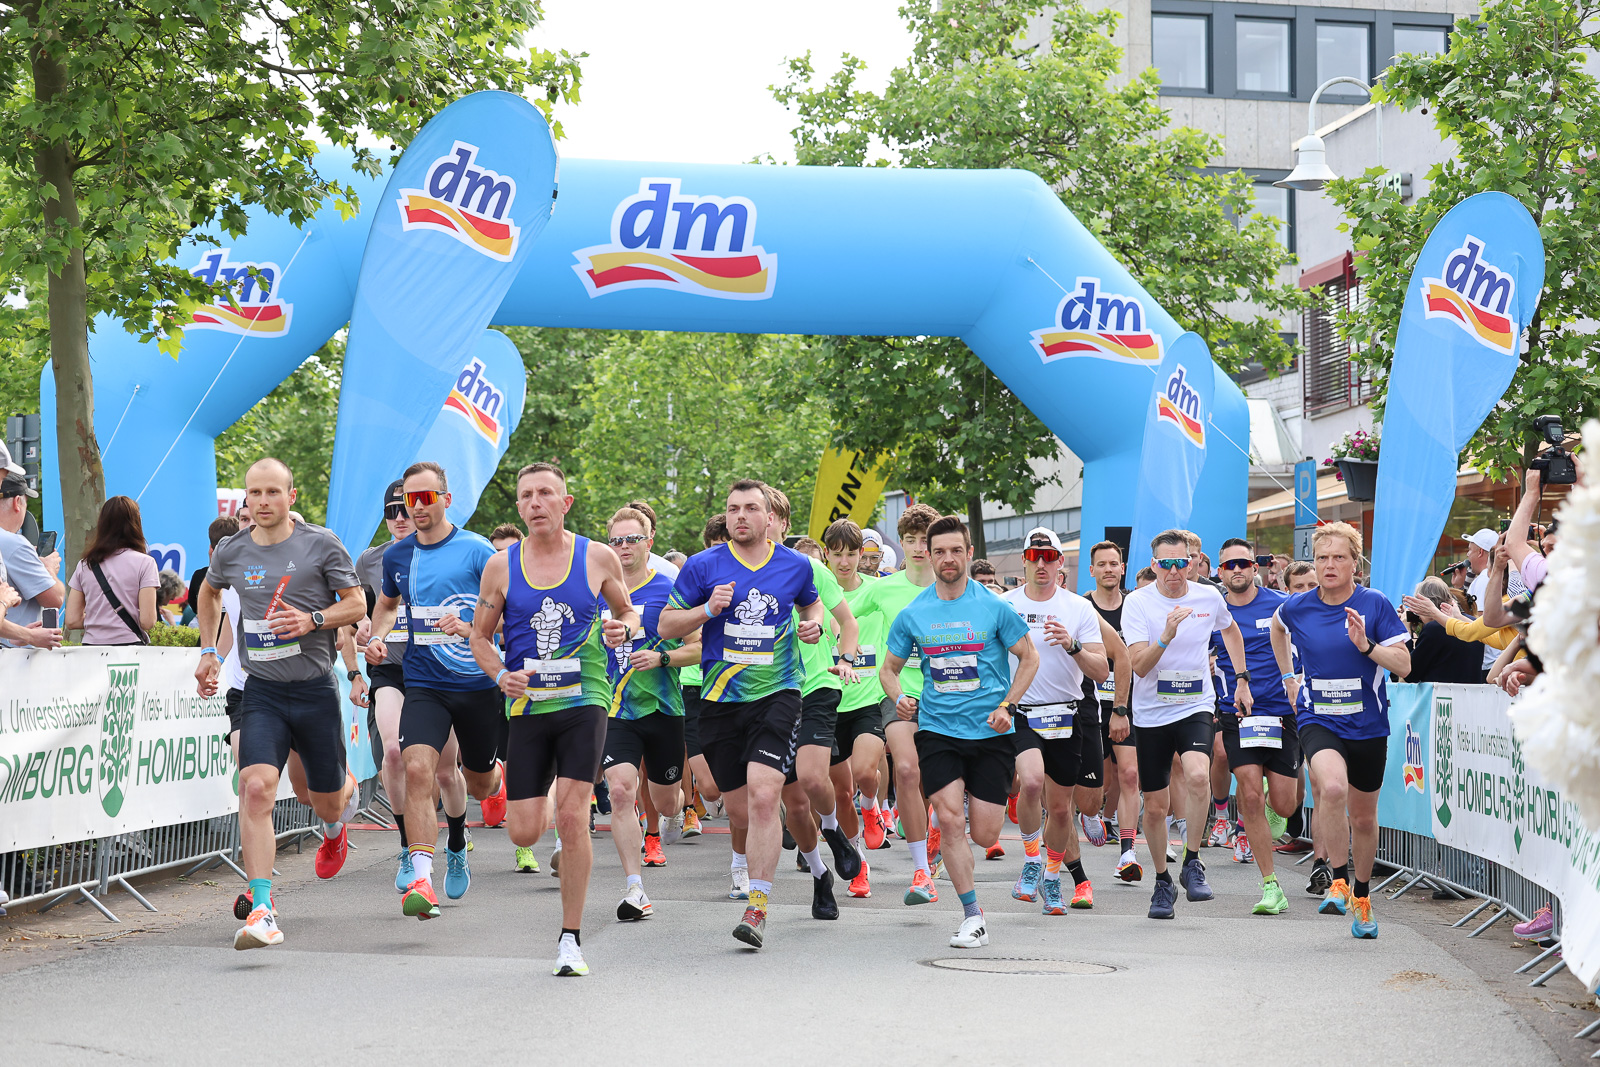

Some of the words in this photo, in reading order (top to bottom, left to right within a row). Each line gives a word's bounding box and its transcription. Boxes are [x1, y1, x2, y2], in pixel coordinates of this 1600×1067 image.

[429, 148, 511, 221] dm
[620, 183, 748, 252] dm
[1446, 241, 1511, 314] dm
[1061, 282, 1141, 332] dm
[456, 362, 500, 418] dm
[1167, 368, 1198, 419] dm
[1300, 469, 1311, 517] P
[257, 633, 277, 642] Yves
[734, 637, 762, 647] Jeremy
[540, 674, 562, 682] Marc
[942, 668, 963, 676] Jonas
[1321, 690, 1352, 698] Matthias
[1041, 715, 1062, 724] Martin
[136, 732, 227, 786] HOMBURG
[1406, 723, 1421, 765] dm
